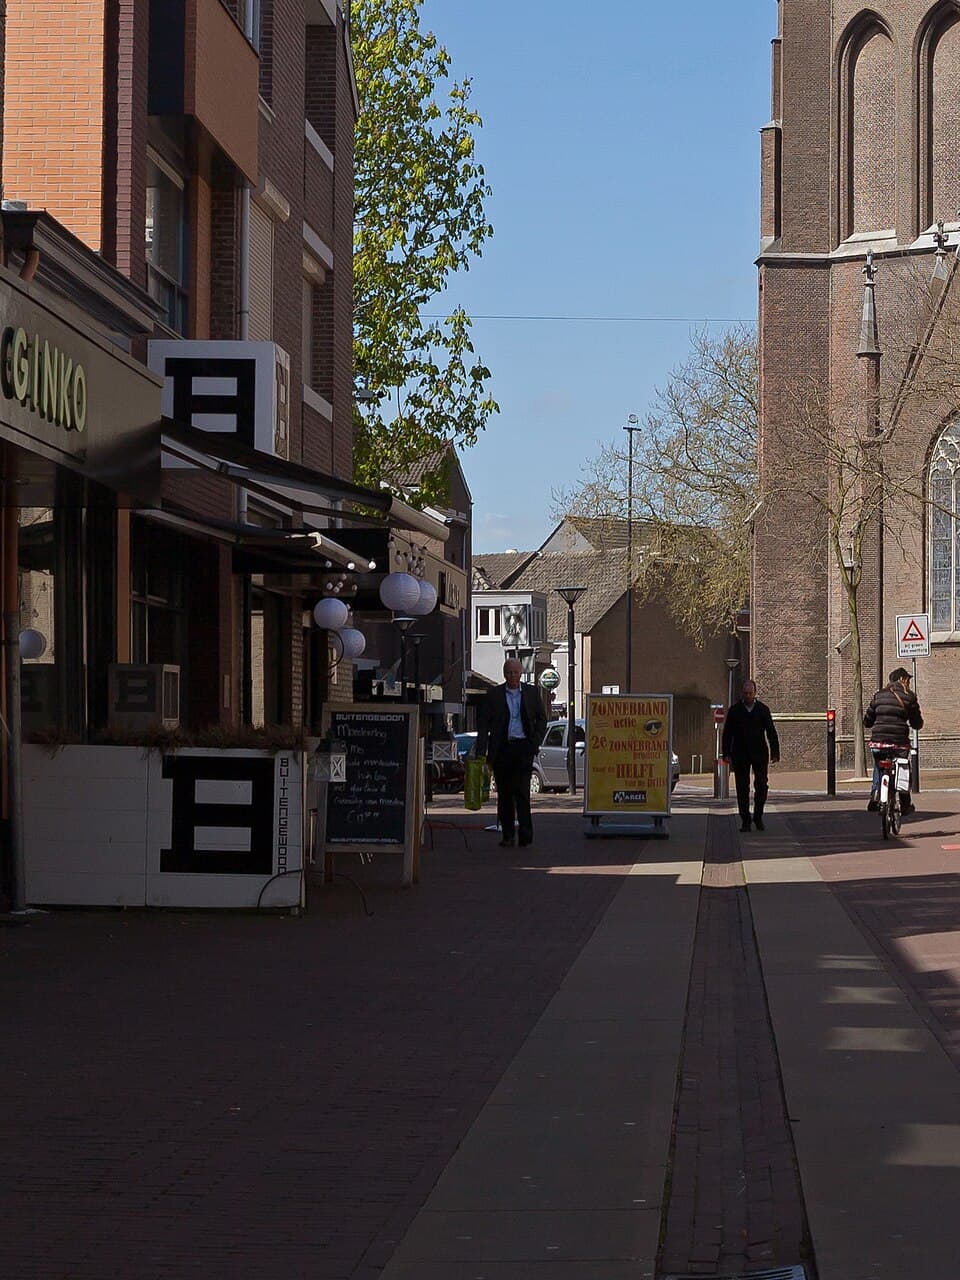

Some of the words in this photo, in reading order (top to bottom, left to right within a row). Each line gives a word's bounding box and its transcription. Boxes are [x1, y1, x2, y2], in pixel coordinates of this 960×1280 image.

[591, 701, 668, 716] ZONNEBRAND
[336, 713, 405, 722] BUITENGEWOON
[591, 735, 607, 750] 2e
[609, 740, 669, 752] ZONNEBRAND
[616, 763, 656, 779] HELFT
[278, 757, 289, 875] BUITENGEWOON
